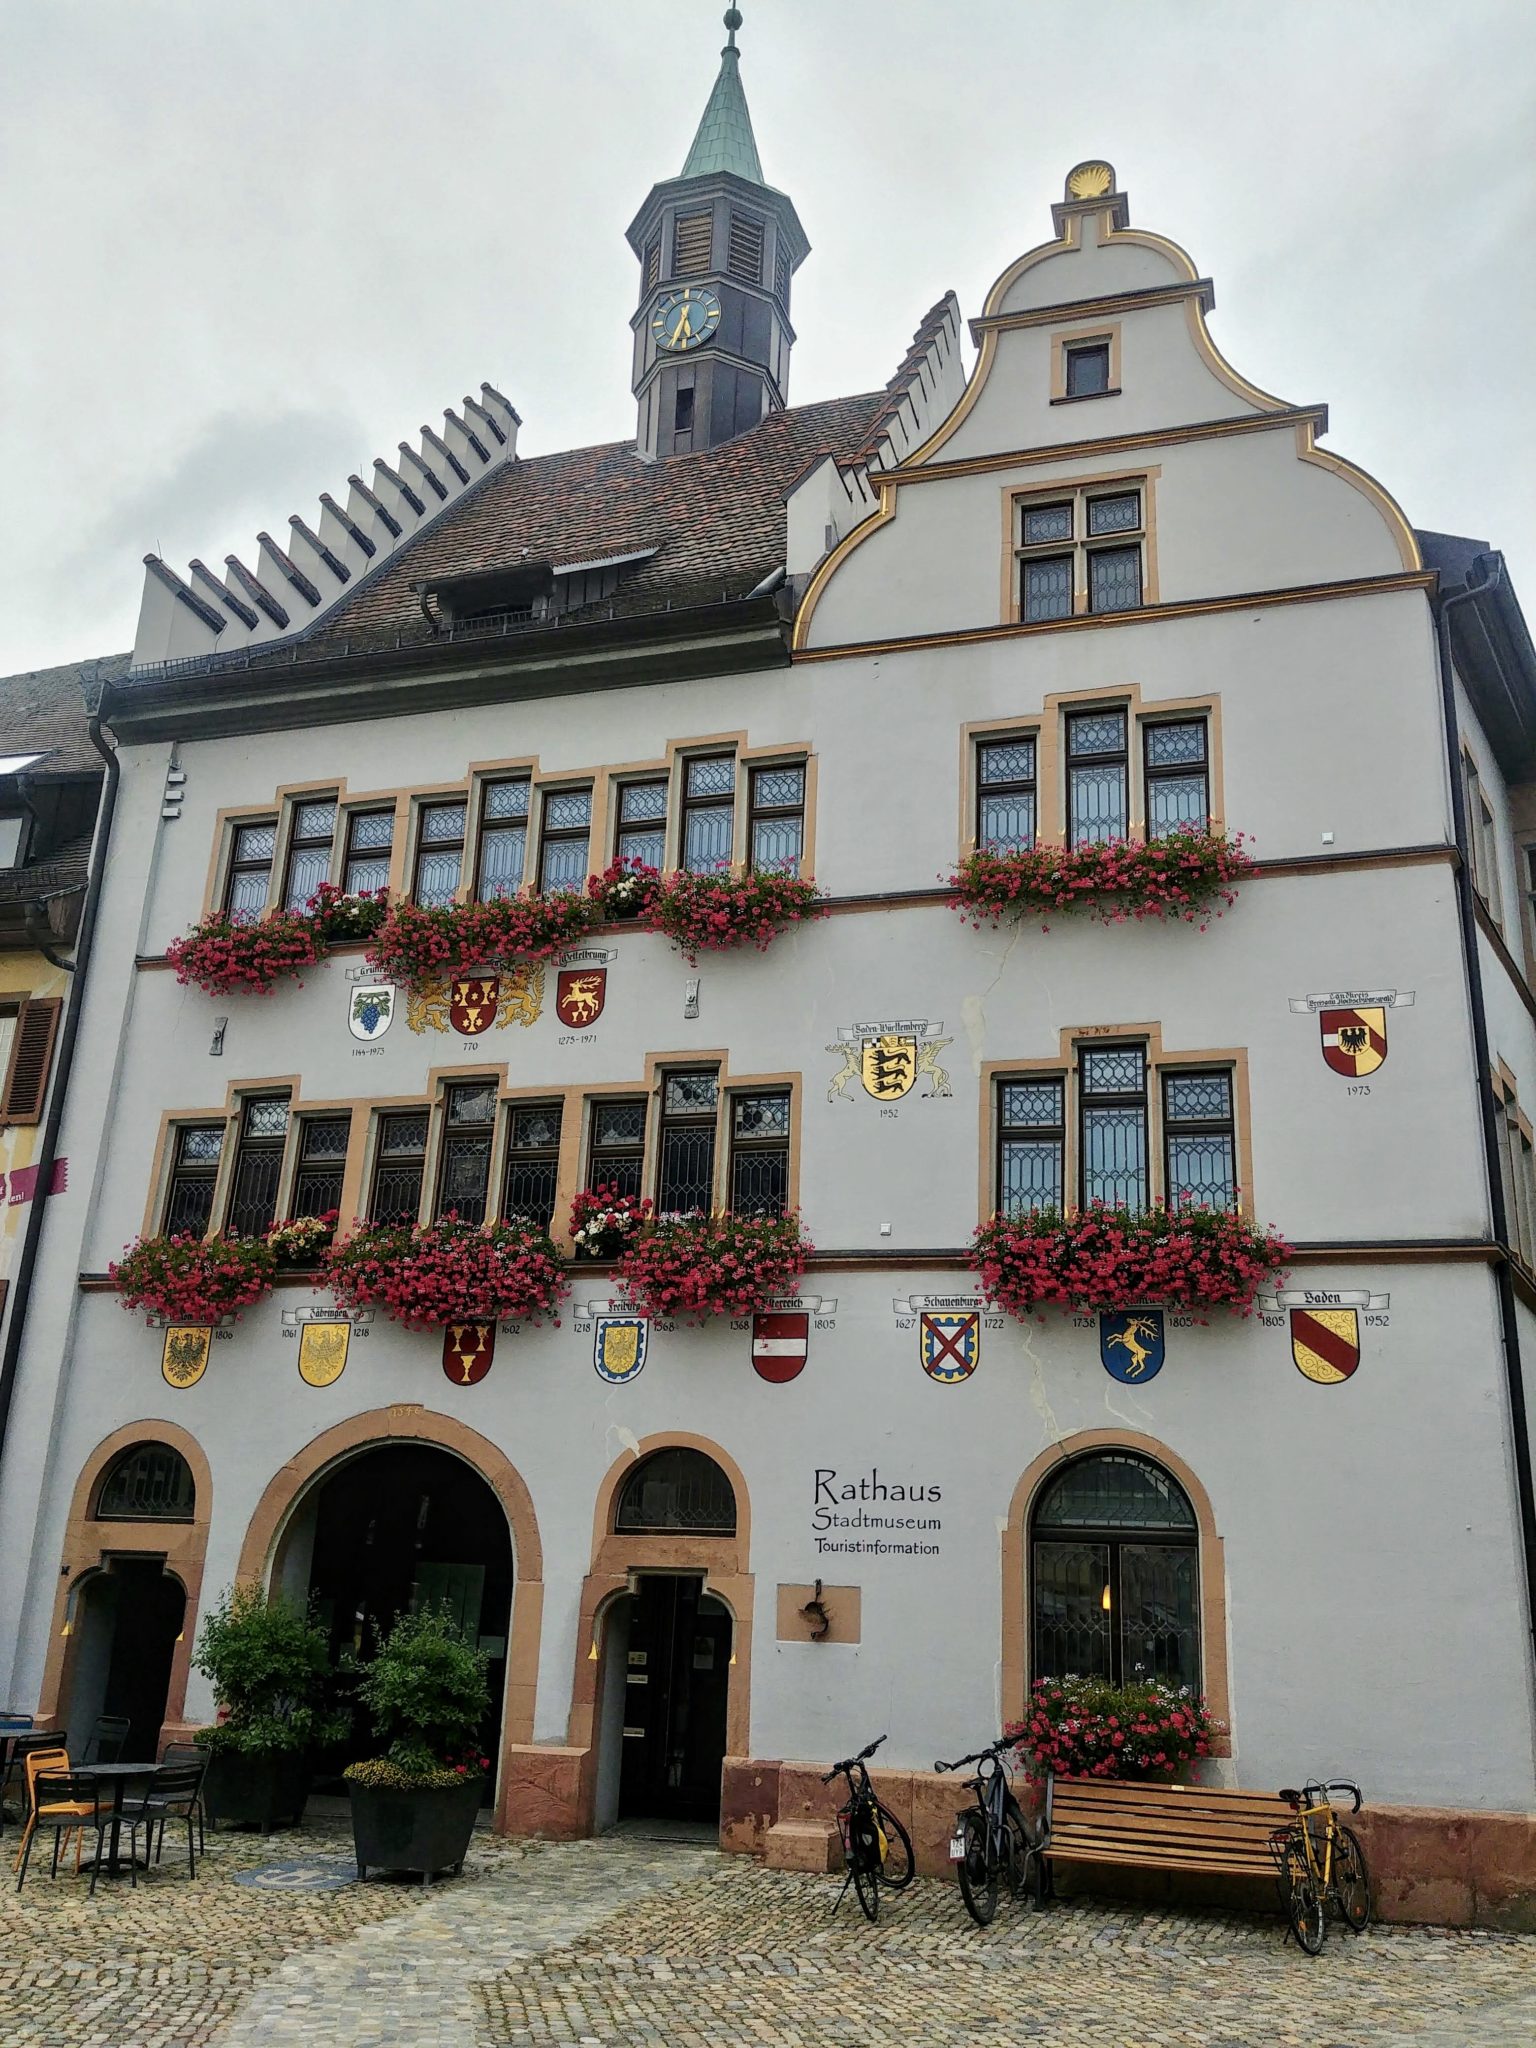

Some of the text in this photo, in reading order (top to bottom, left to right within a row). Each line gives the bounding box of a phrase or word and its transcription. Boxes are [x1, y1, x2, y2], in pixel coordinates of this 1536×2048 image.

[558, 1035, 597, 1045] 1275-1971
[463, 1043, 479, 1051] 770
[1347, 1085, 1372, 1096] 1973
[879, 1109, 899, 1118] 1952
[1304, 1292, 1342, 1304] Baden
[730, 1320, 750, 1331] 1368
[814, 1320, 836, 1330] 1805
[895, 1319, 917, 1329] 1627
[984, 1319, 1005, 1329] 1722
[1072, 1317, 1096, 1328] 1738
[1169, 1317, 1193, 1328] 1805
[1262, 1315, 1286, 1327] 1805
[1364, 1315, 1390, 1327] 1952
[353, 1328, 370, 1337] 1218
[501, 1324, 521, 1335] 1602
[574, 1323, 591, 1333] 1218
[814, 1467, 942, 1505] Rathaus
[811, 1506, 942, 1531] Stadtmuseum
[814, 1537, 940, 1555] Touristinformation
